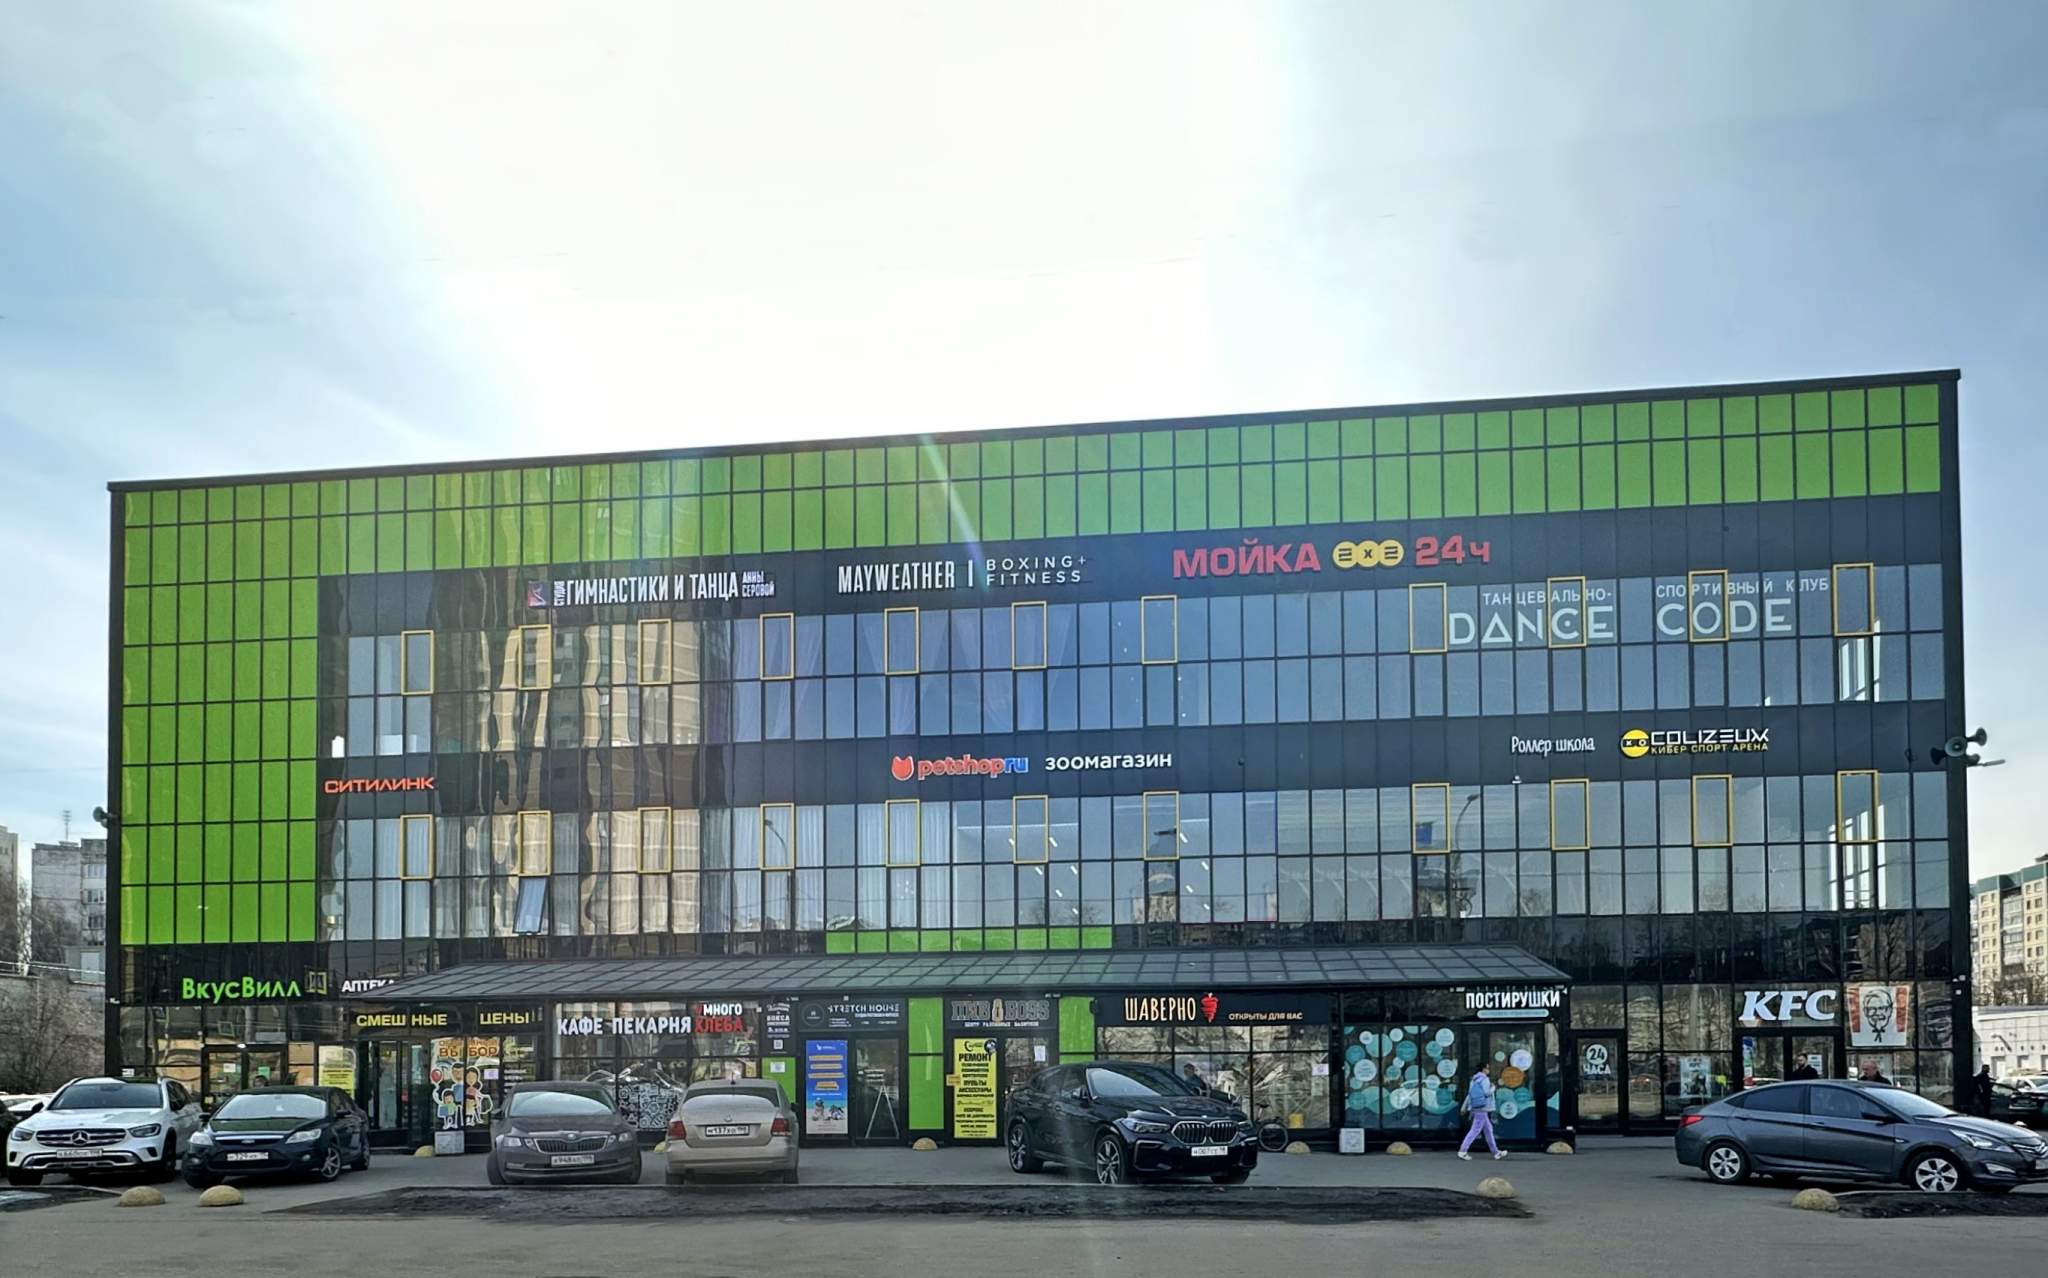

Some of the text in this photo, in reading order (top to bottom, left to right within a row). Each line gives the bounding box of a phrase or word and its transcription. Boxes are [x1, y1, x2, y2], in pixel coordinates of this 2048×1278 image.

[1173, 538, 1321, 578] МОЙКА
[742, 571, 764, 583] АННЫ
[838, 561, 955, 593] MAYWEATHER
[987, 570, 1082, 586] FITNESS
[567, 572, 739, 605] ГИМНАСТИКИ И ТАНЦА
[742, 581, 775, 597] СЕРОВОЙ
[1656, 577, 1829, 598] СПОРТИВНЫЙ КЛУБ
[1449, 598, 1792, 644] DANCE CODE
[1511, 736, 1596, 757] Роллер школа
[1651, 742, 1769, 754] КИБЕР СПОРТ АРЕНА
[1045, 753, 1172, 771] зоомагазин
[325, 777, 435, 793] СИТИЛИНК
[182, 977, 301, 1003] ВкусВилл
[1465, 990, 1561, 1009] ПОСТИРУШКИ
[1738, 989, 1836, 1022] KFC
[1125, 997, 1196, 1021] ШАВЕРНО
[1268, 1012, 1285, 1020] ДЛЯ
[1287, 1012, 1303, 1020] ВАС
[480, 1012, 529, 1025] ЦЕНЫ
[557, 1017, 691, 1035] КАФЕ ПЕКАРНЯ
[695, 1016, 743, 1033] ХЛЕБА
[958, 1053, 991, 1062] РЕМОНТ
[1589, 1048, 1605, 1060] 24
[1583, 1064, 1611, 1075] ЧАСА
